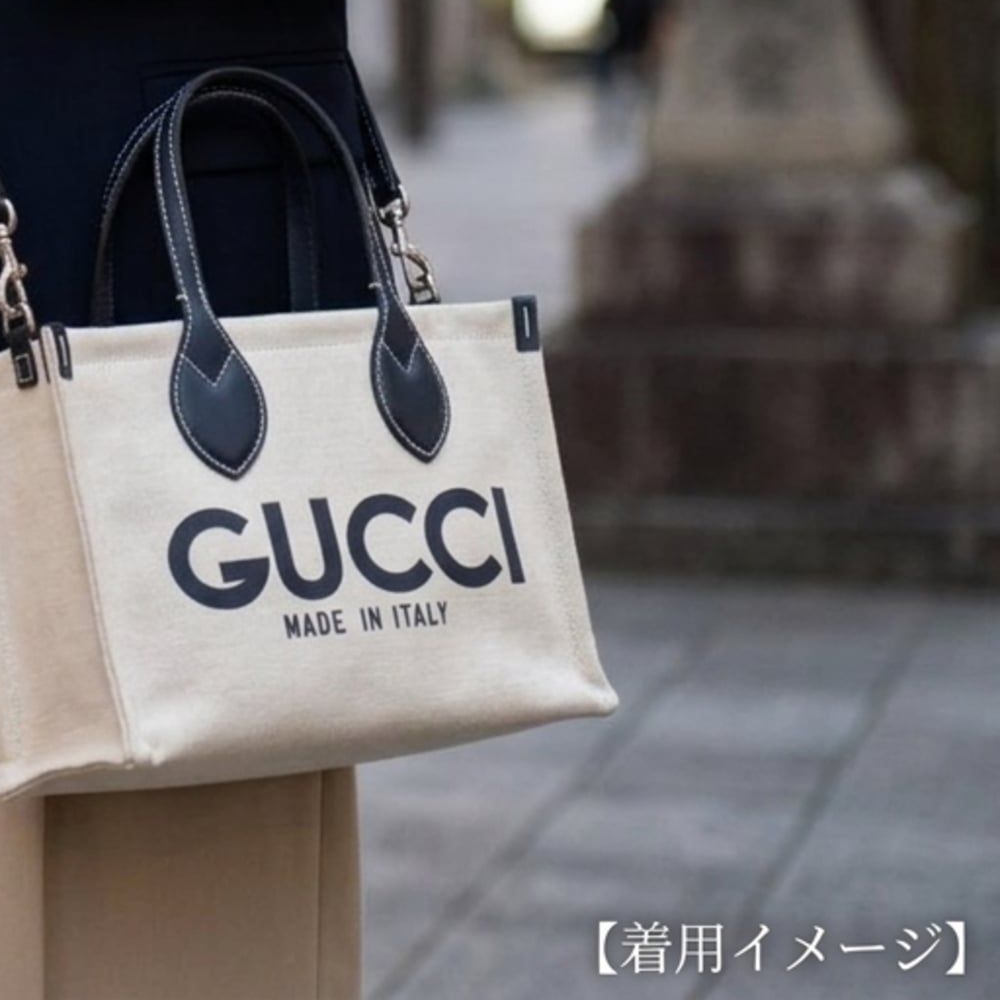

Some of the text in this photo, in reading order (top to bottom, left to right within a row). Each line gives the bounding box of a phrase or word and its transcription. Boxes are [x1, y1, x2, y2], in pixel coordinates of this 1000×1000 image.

[167, 486, 526, 610] GUCCI
[283, 600, 449, 639] MADE IN ITALY
